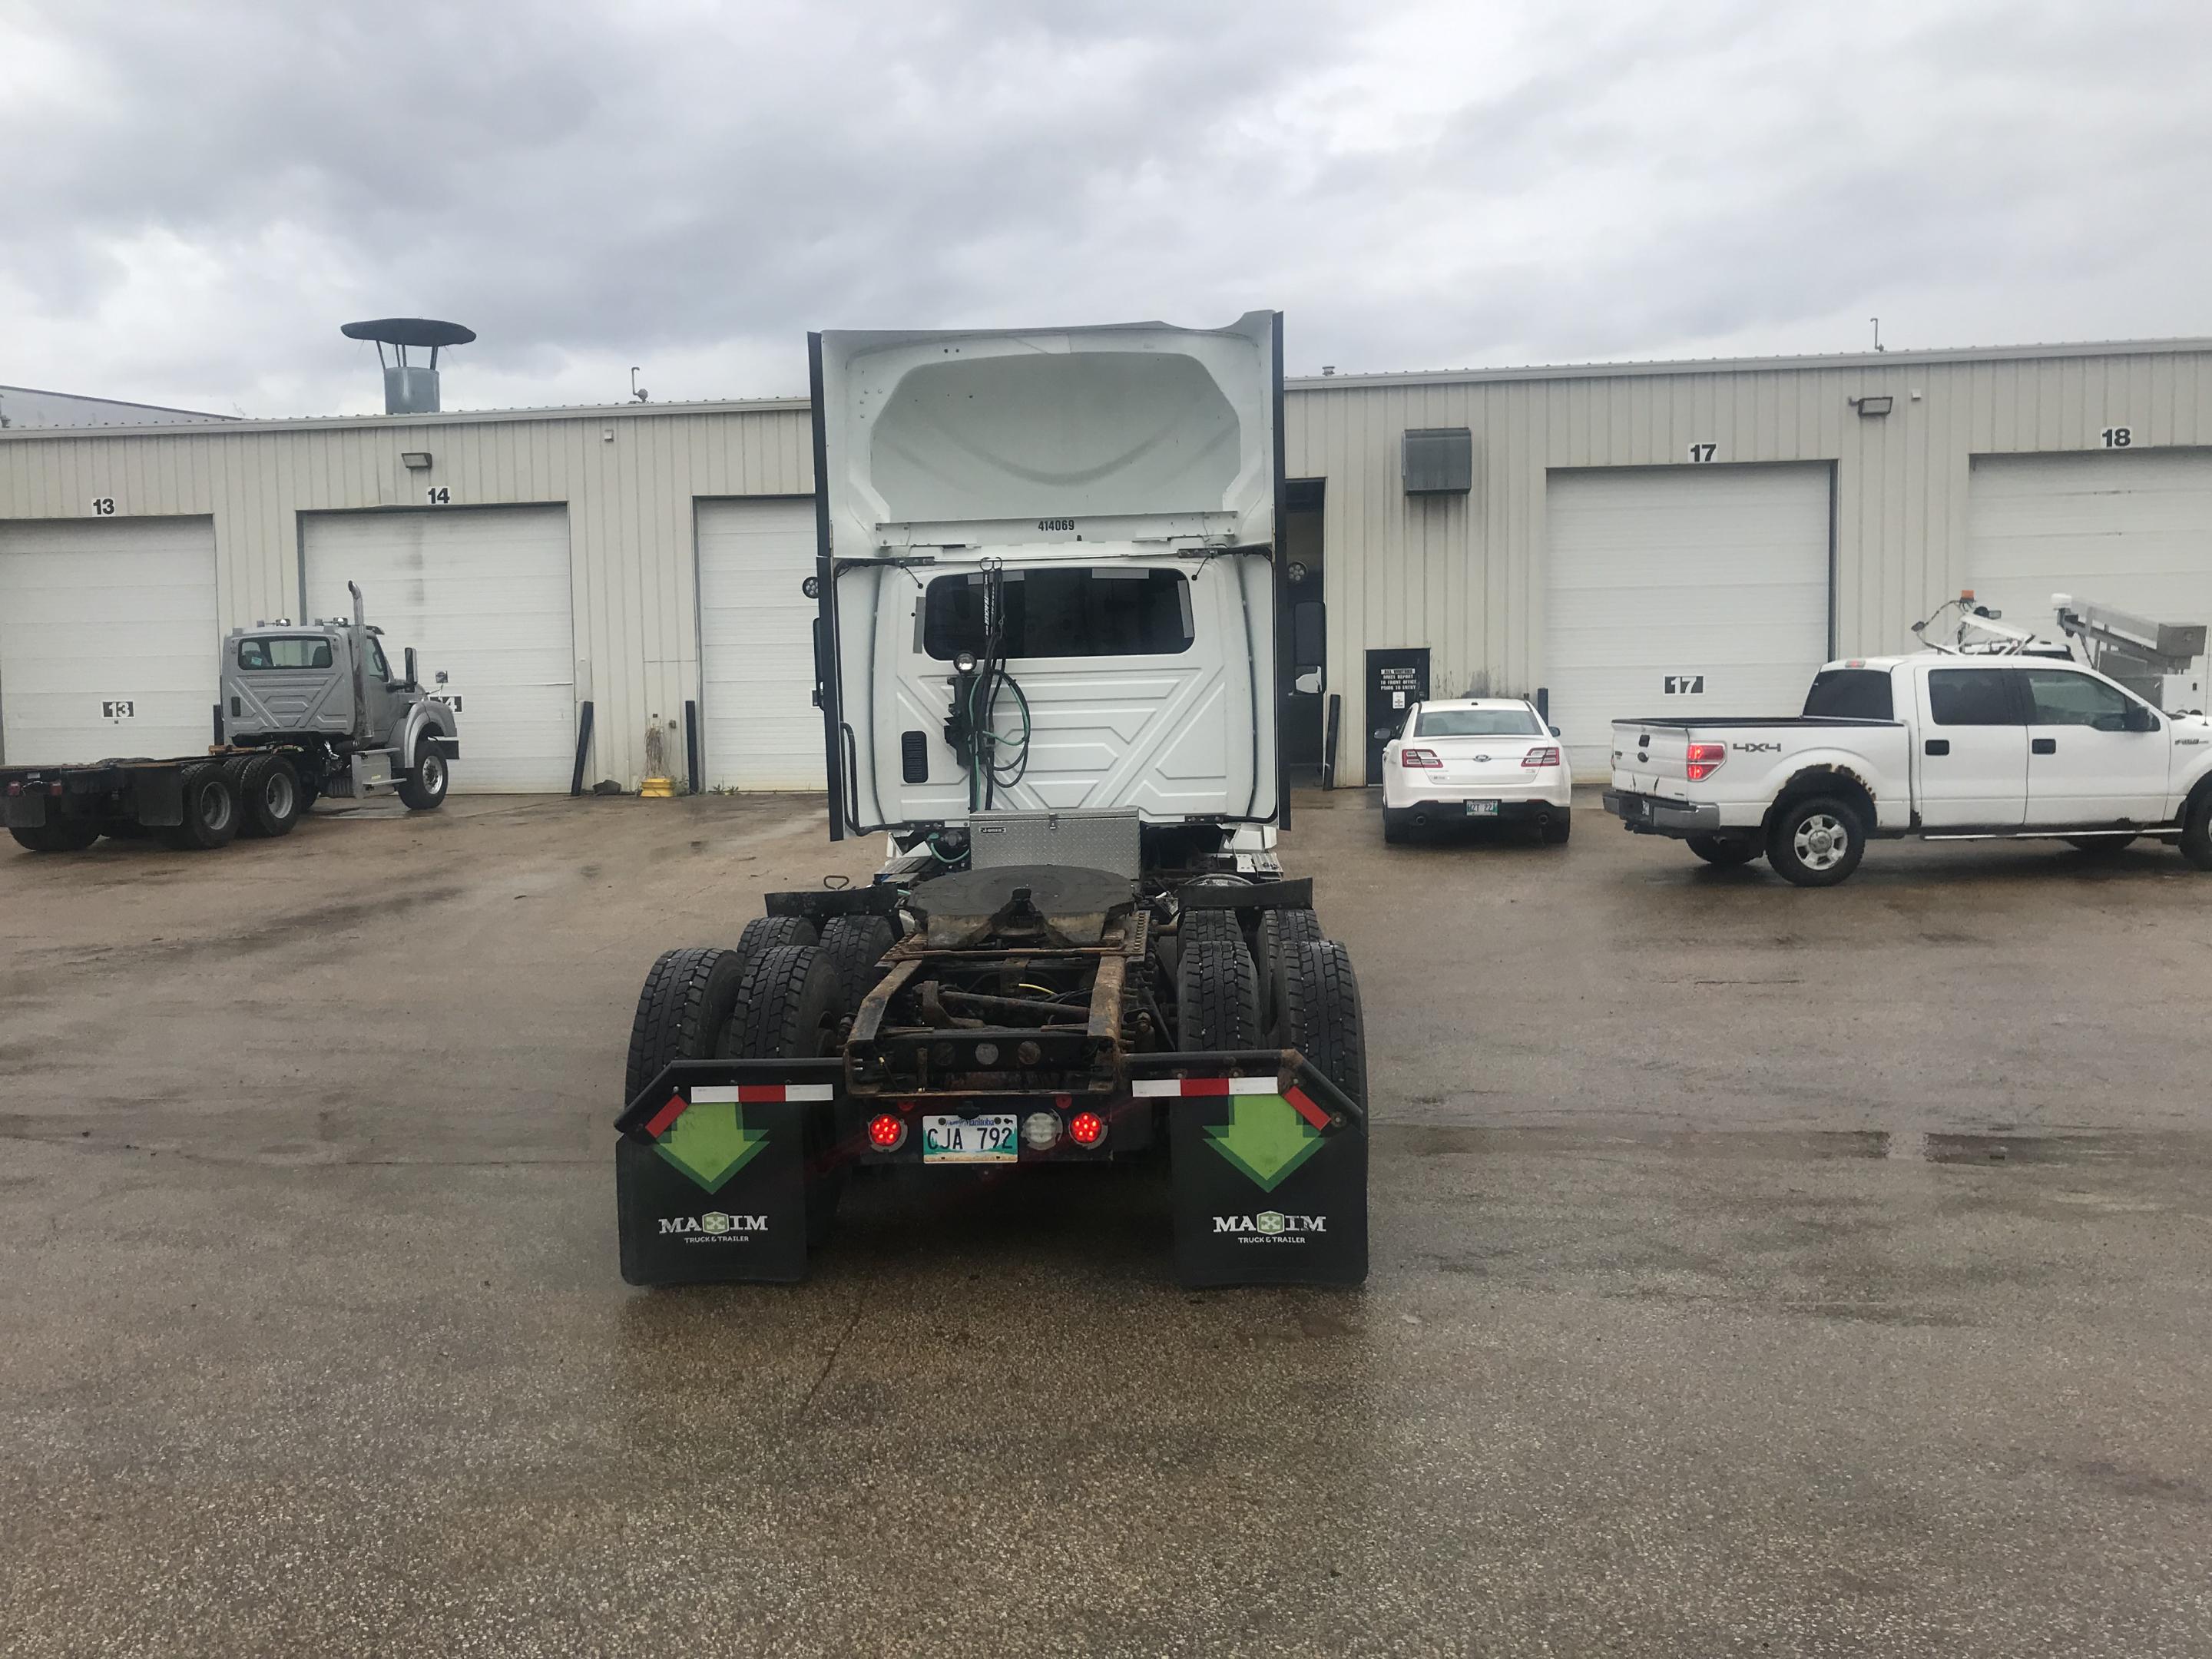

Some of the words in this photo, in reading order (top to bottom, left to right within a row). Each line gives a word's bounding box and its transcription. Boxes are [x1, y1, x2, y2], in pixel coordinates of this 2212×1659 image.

[2102, 428, 2131, 447] 18
[1690, 444, 1717, 462] 17
[428, 488, 450, 504] 14
[93, 498, 114, 515] 13
[1038, 519, 1075, 531] 414069
[1671, 676, 1697, 694] 17
[109, 702, 130, 717] 13
[927, 1128, 963, 1150] CJA
[977, 1127, 1013, 1149] 792
[658, 1211, 769, 1233] MAXIM
[1213, 1210, 1326, 1235] MAXIM
